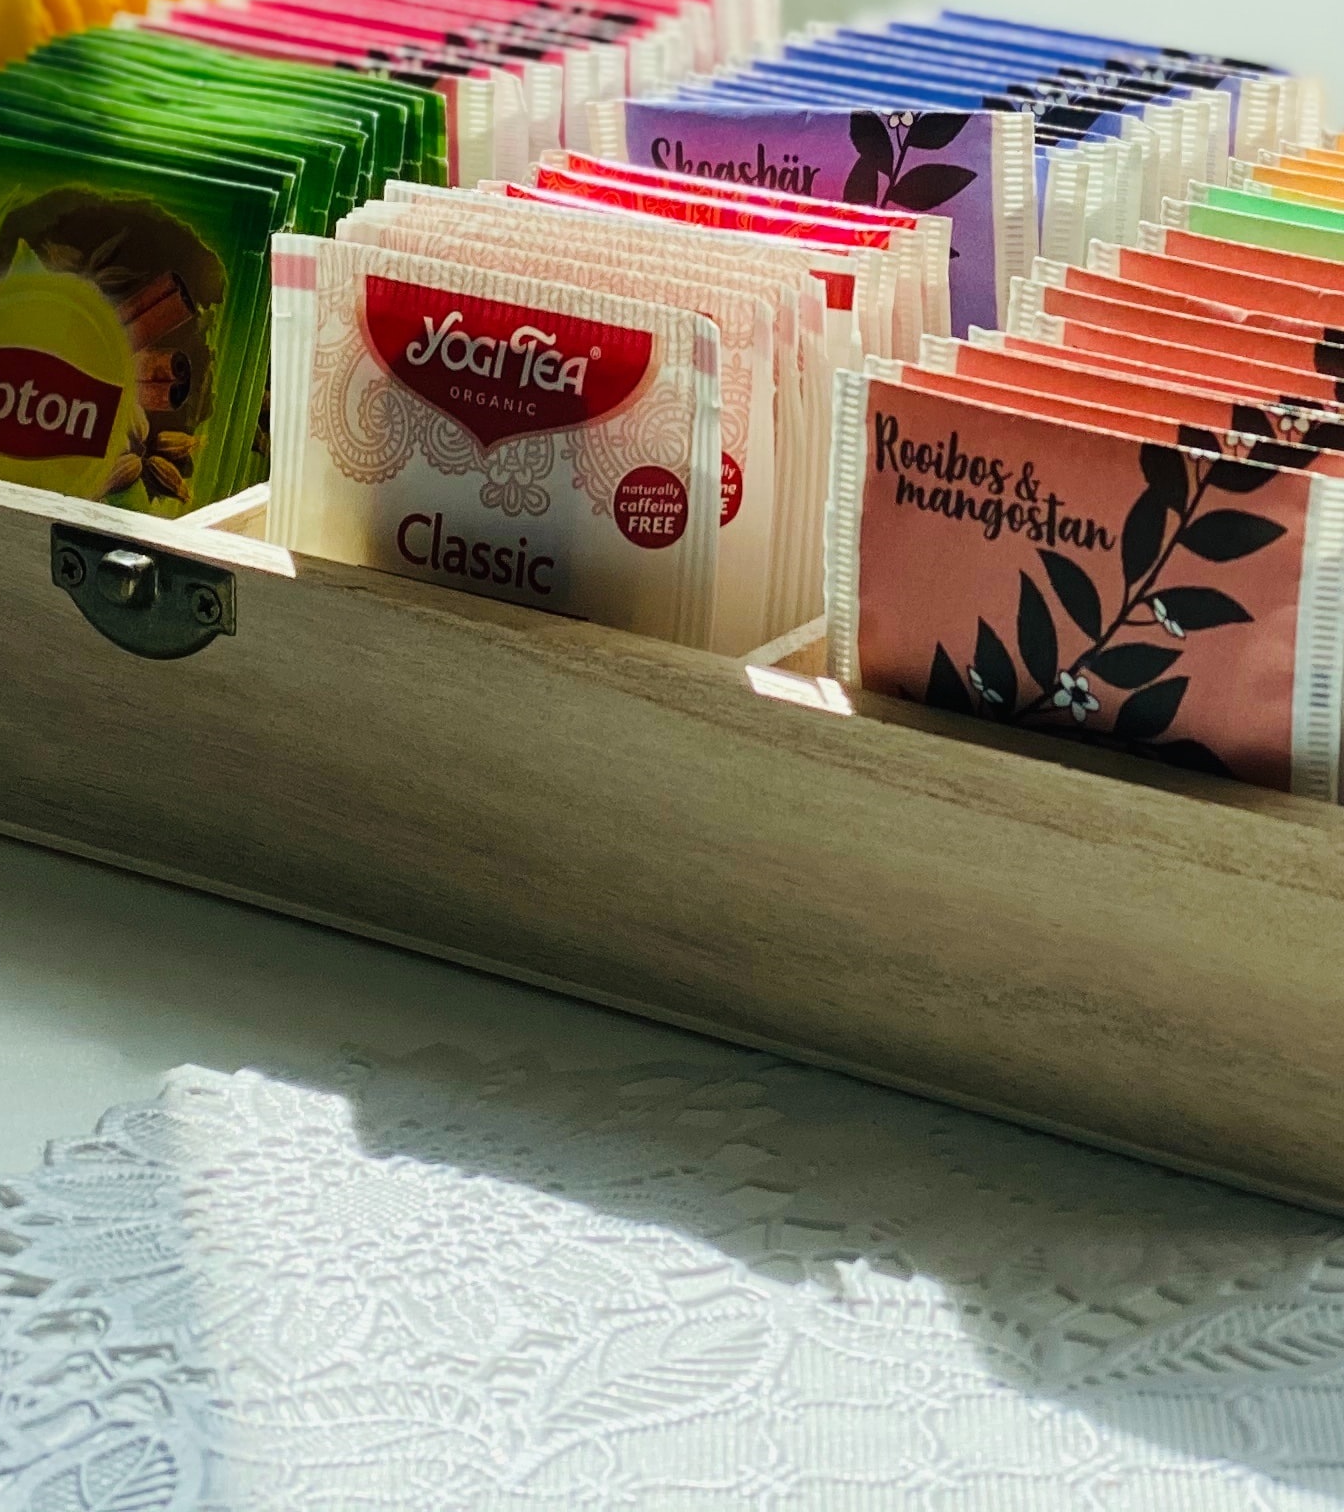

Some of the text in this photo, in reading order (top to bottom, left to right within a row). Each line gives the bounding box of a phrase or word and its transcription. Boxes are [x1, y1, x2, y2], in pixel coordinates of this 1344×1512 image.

[510, 325, 589, 396] TEA
[450, 386, 537, 417] ORGANIC
[875, 410, 1041, 502] Rooibos &
[619, 498, 683, 514] caffeine
[622, 482, 681, 500] naturally
[895, 474, 1116, 551] mangostan
[627, 516, 676, 535] FREE
[397, 512, 555, 595] Classic
